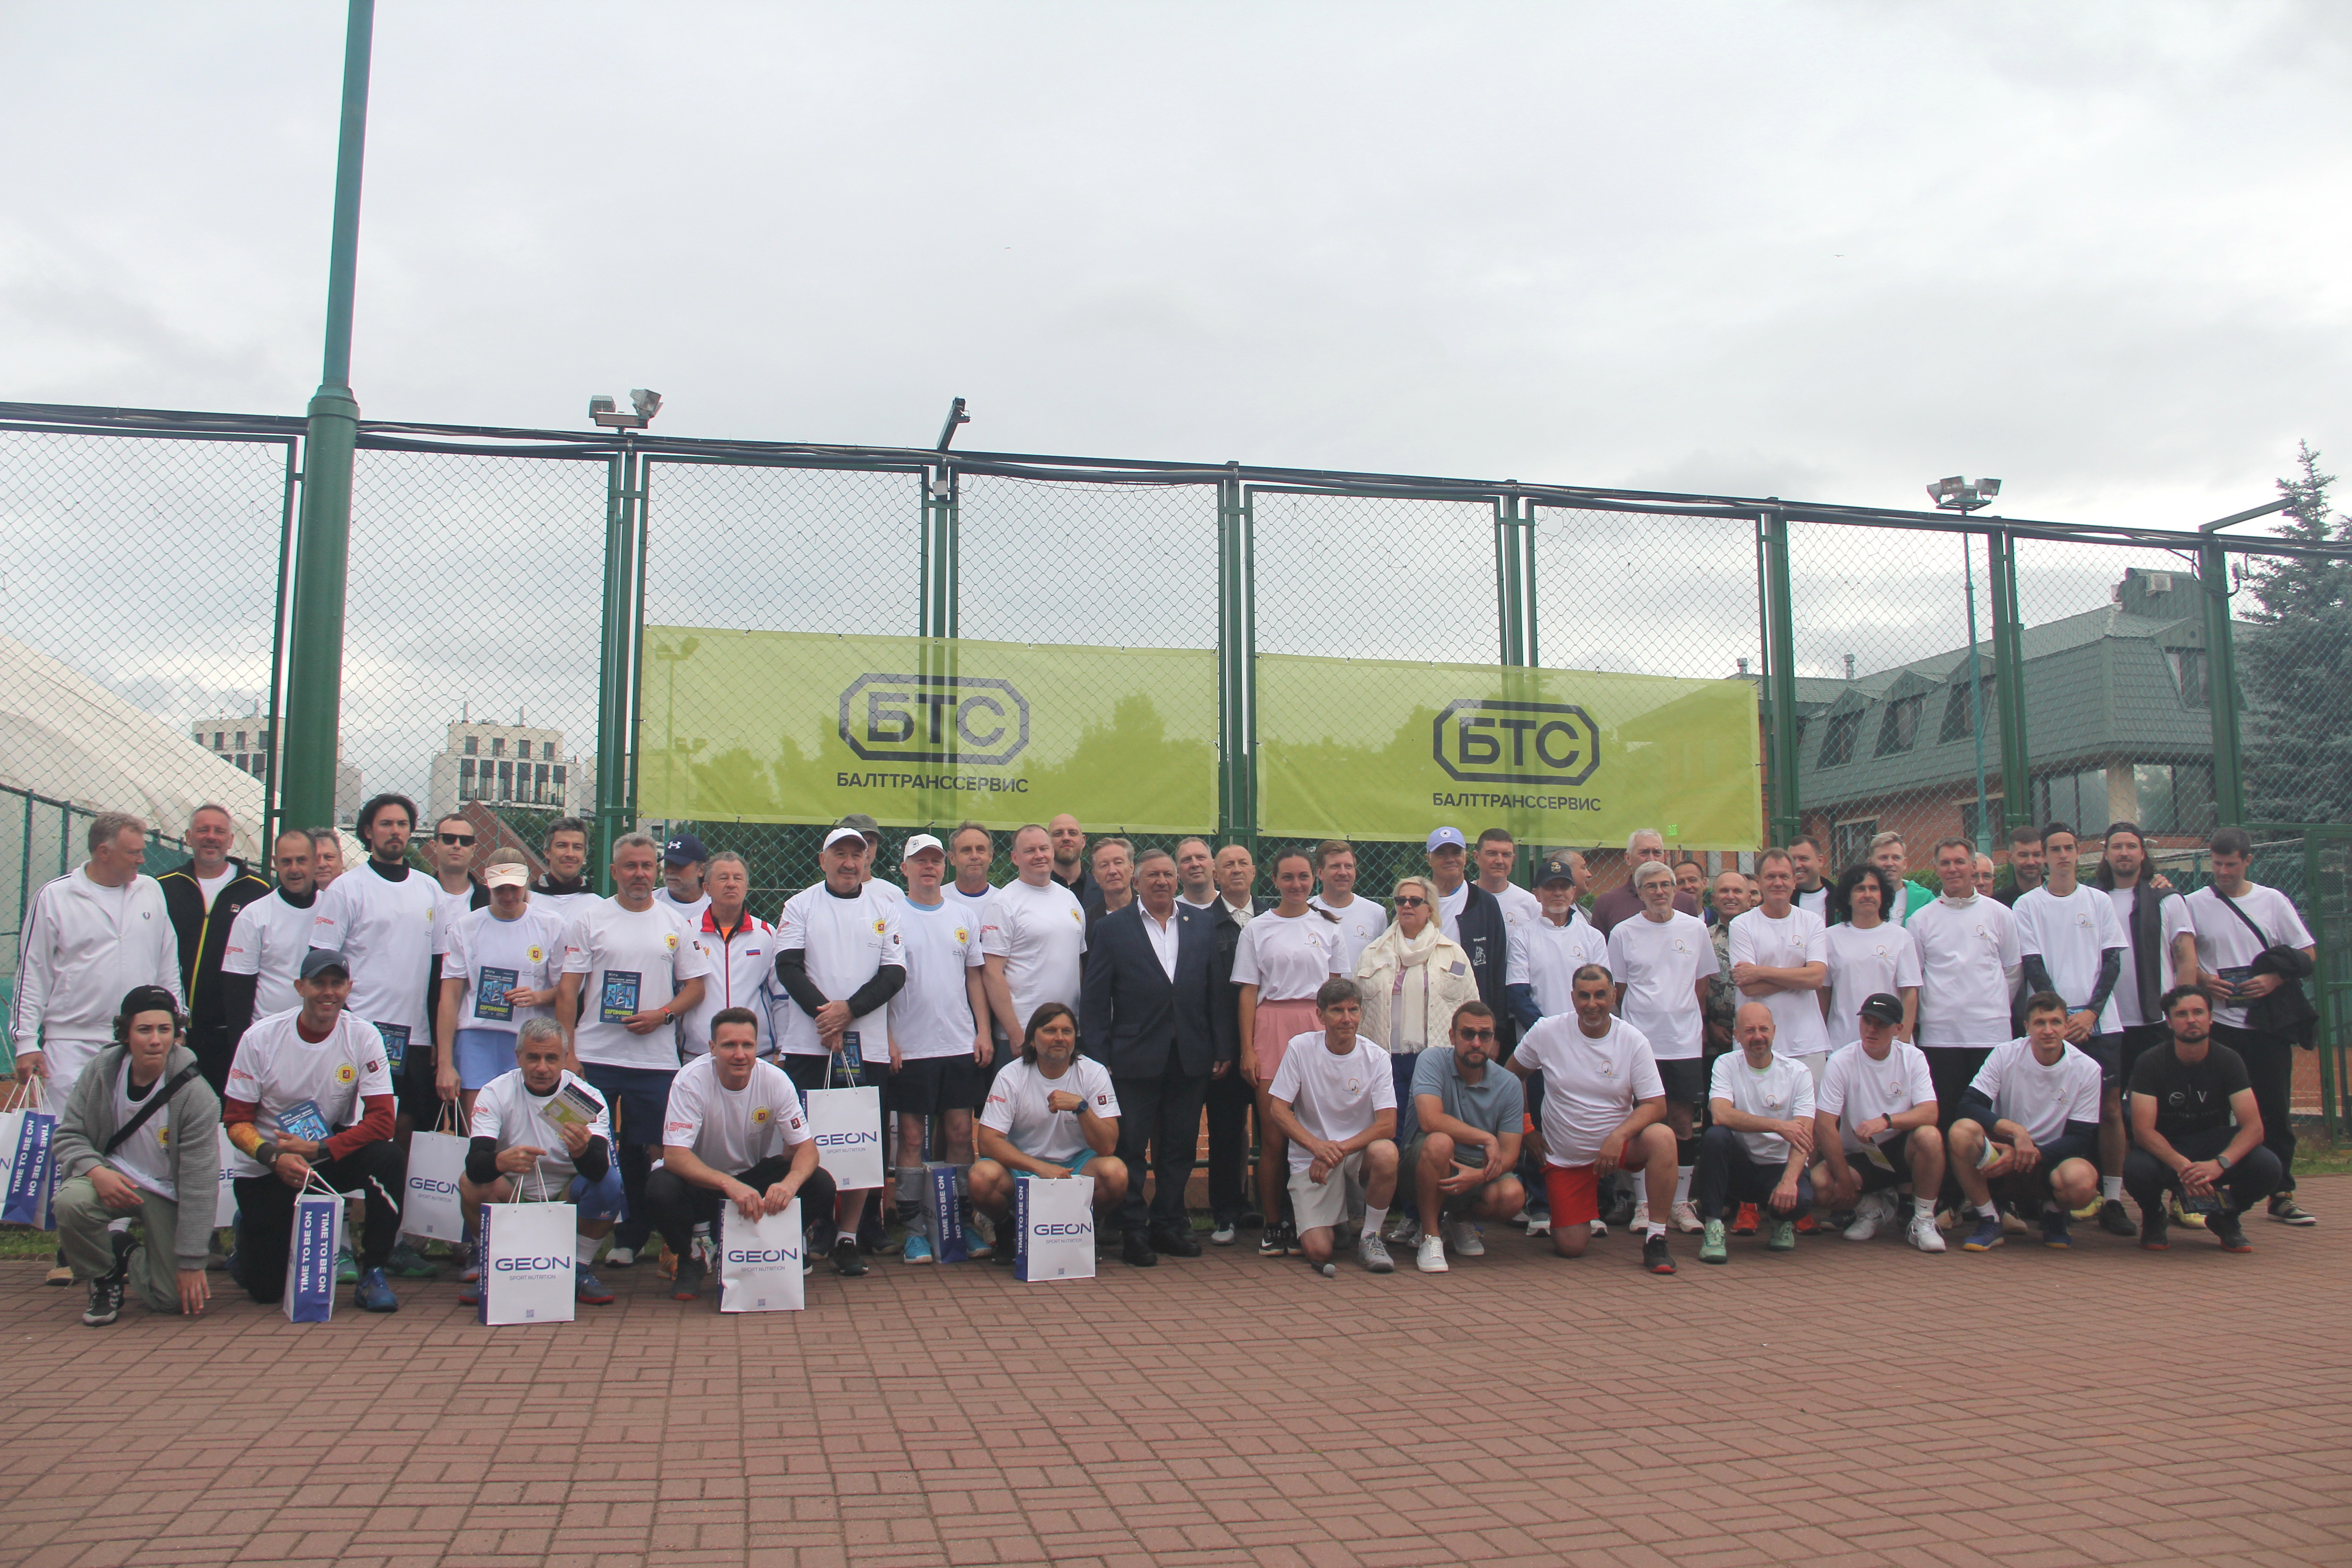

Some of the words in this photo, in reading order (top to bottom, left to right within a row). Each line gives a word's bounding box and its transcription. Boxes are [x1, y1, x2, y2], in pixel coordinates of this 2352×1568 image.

[867, 691, 1006, 747] БТС
[1459, 717, 1579, 769] БТС
[837, 772, 1029, 793] БАЛТТРАНССЕРВИС
[1433, 792, 1601, 812] БАЛТТРАНССЕРВИС
[26, 1120, 35, 1135] ON
[40, 1123, 49, 1147] TIME
[23, 1137, 32, 1151] BE
[814, 1131, 877, 1146] GEON
[19, 1153, 28, 1167] TO
[36, 1149, 45, 1163] TO
[32, 1165, 42, 1179] BE
[12, 1168, 24, 1194] TIME
[27, 1181, 37, 1196] ON
[938, 1175, 945, 1190] ON
[940, 1190, 945, 1203] BE
[1019, 1186, 1023, 1200] ON
[941, 1204, 947, 1217] TO
[1019, 1201, 1023, 1214] BE
[304, 1211, 312, 1228] ON
[321, 1211, 329, 1239] TIME
[1019, 1216, 1023, 1229] TO
[956, 1225, 961, 1239] ON
[1034, 1221, 1091, 1235] GEON
[304, 1230, 311, 1245] BE
[303, 1247, 310, 1263] TO
[320, 1240, 328, 1256] TO
[728, 1248, 797, 1263] GEON
[319, 1258, 327, 1274] BE
[495, 1256, 570, 1271] GEON
[300, 1265, 309, 1293] TIME
[318, 1275, 326, 1292] ON
